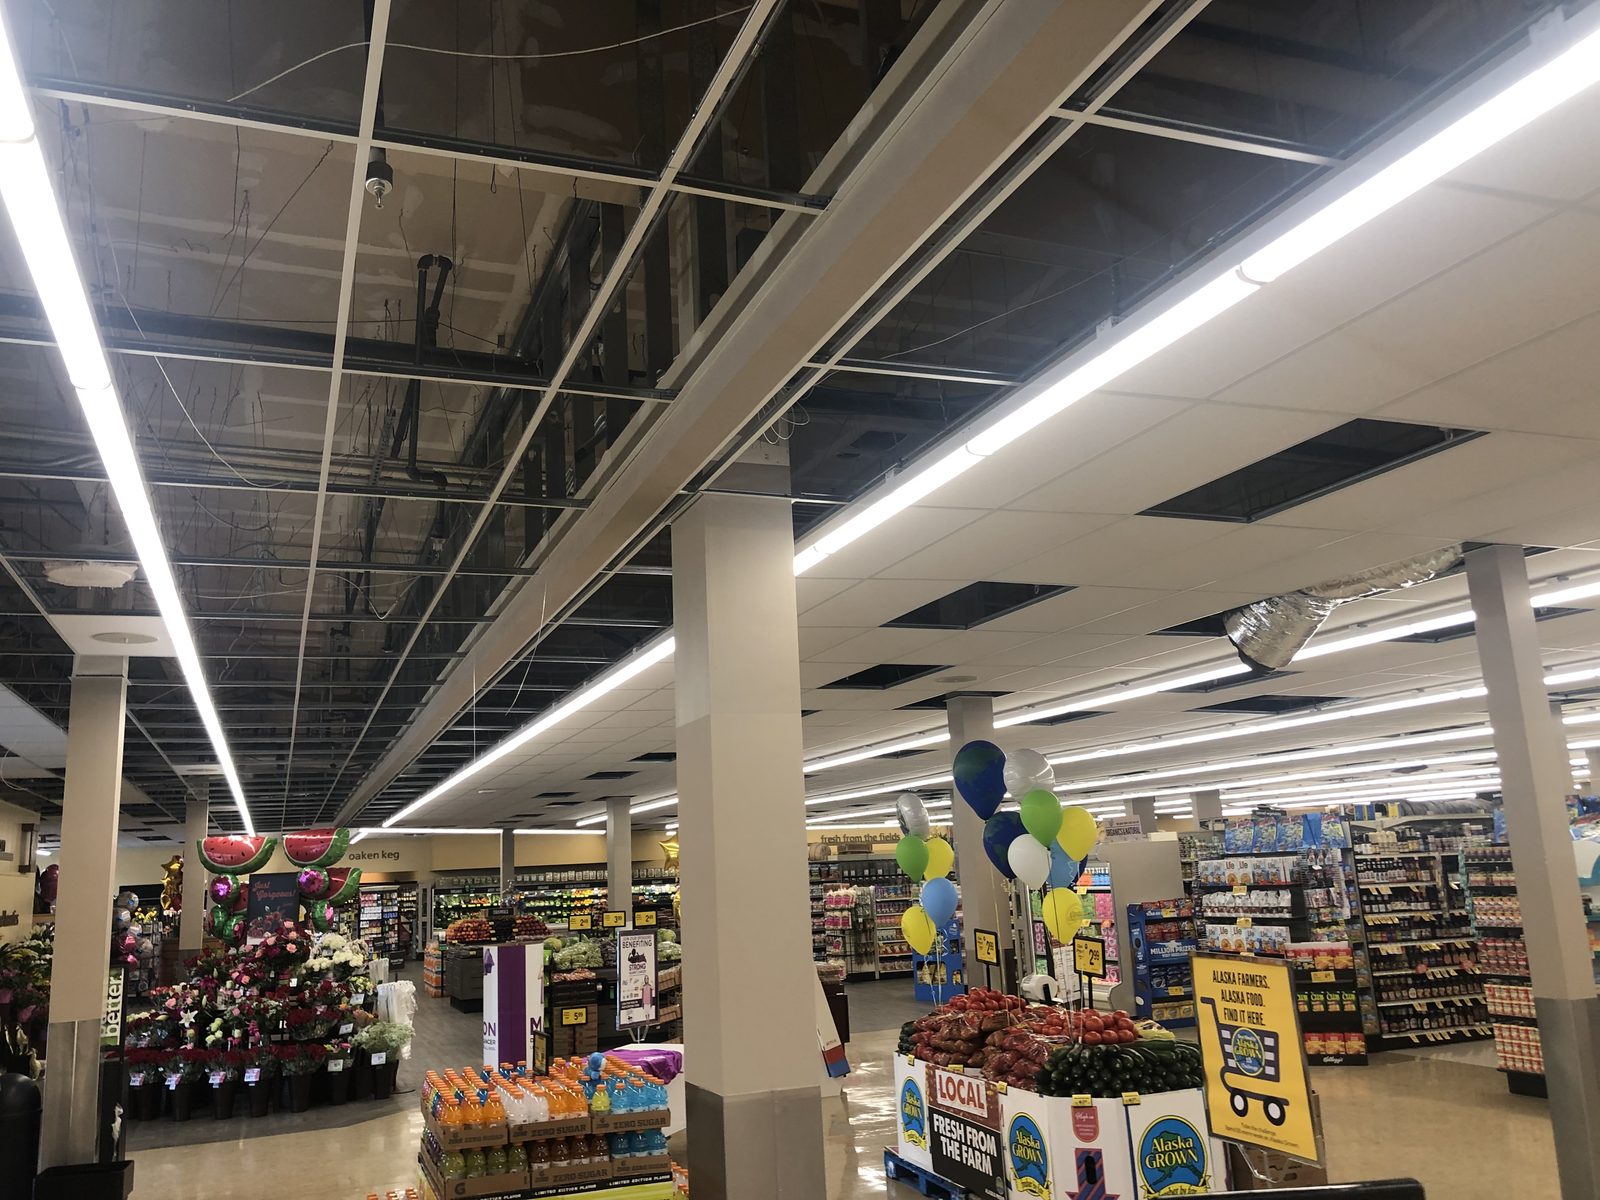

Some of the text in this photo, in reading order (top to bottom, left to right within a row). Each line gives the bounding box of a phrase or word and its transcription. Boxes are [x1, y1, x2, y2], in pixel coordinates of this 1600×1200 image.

[820, 832, 900, 844] fresh from the fields
[348, 850, 400, 860] oaken keg
[622, 940, 652, 949] BENEFITING
[1150, 946, 1175, 954] MILLION
[1088, 948, 1100, 966] 299
[628, 962, 646, 972] STRONG
[1212, 970, 1270, 989] ALASKA FARMERS.
[107, 976, 122, 1036] better.
[1220, 988, 1266, 1008] ALASKA FOOD.
[1224, 1008, 1266, 1026] FIND IT HERE.
[938, 1074, 985, 1110] LOCAL
[532, 1124, 586, 1137] ZERO SUGAR
[614, 1118, 666, 1130] ZERO SUGAR
[933, 1113, 997, 1157] FRESH FROM
[1016, 1130, 1040, 1150] Alaska
[1012, 1141, 1044, 1164] GROWN
[1152, 1136, 1193, 1153] Alaska
[940, 1136, 992, 1176] THE FARM
[1146, 1148, 1198, 1169] GROWN
[553, 1168, 608, 1182] ZERO SUGAR
[455, 1182, 466, 1195] G
